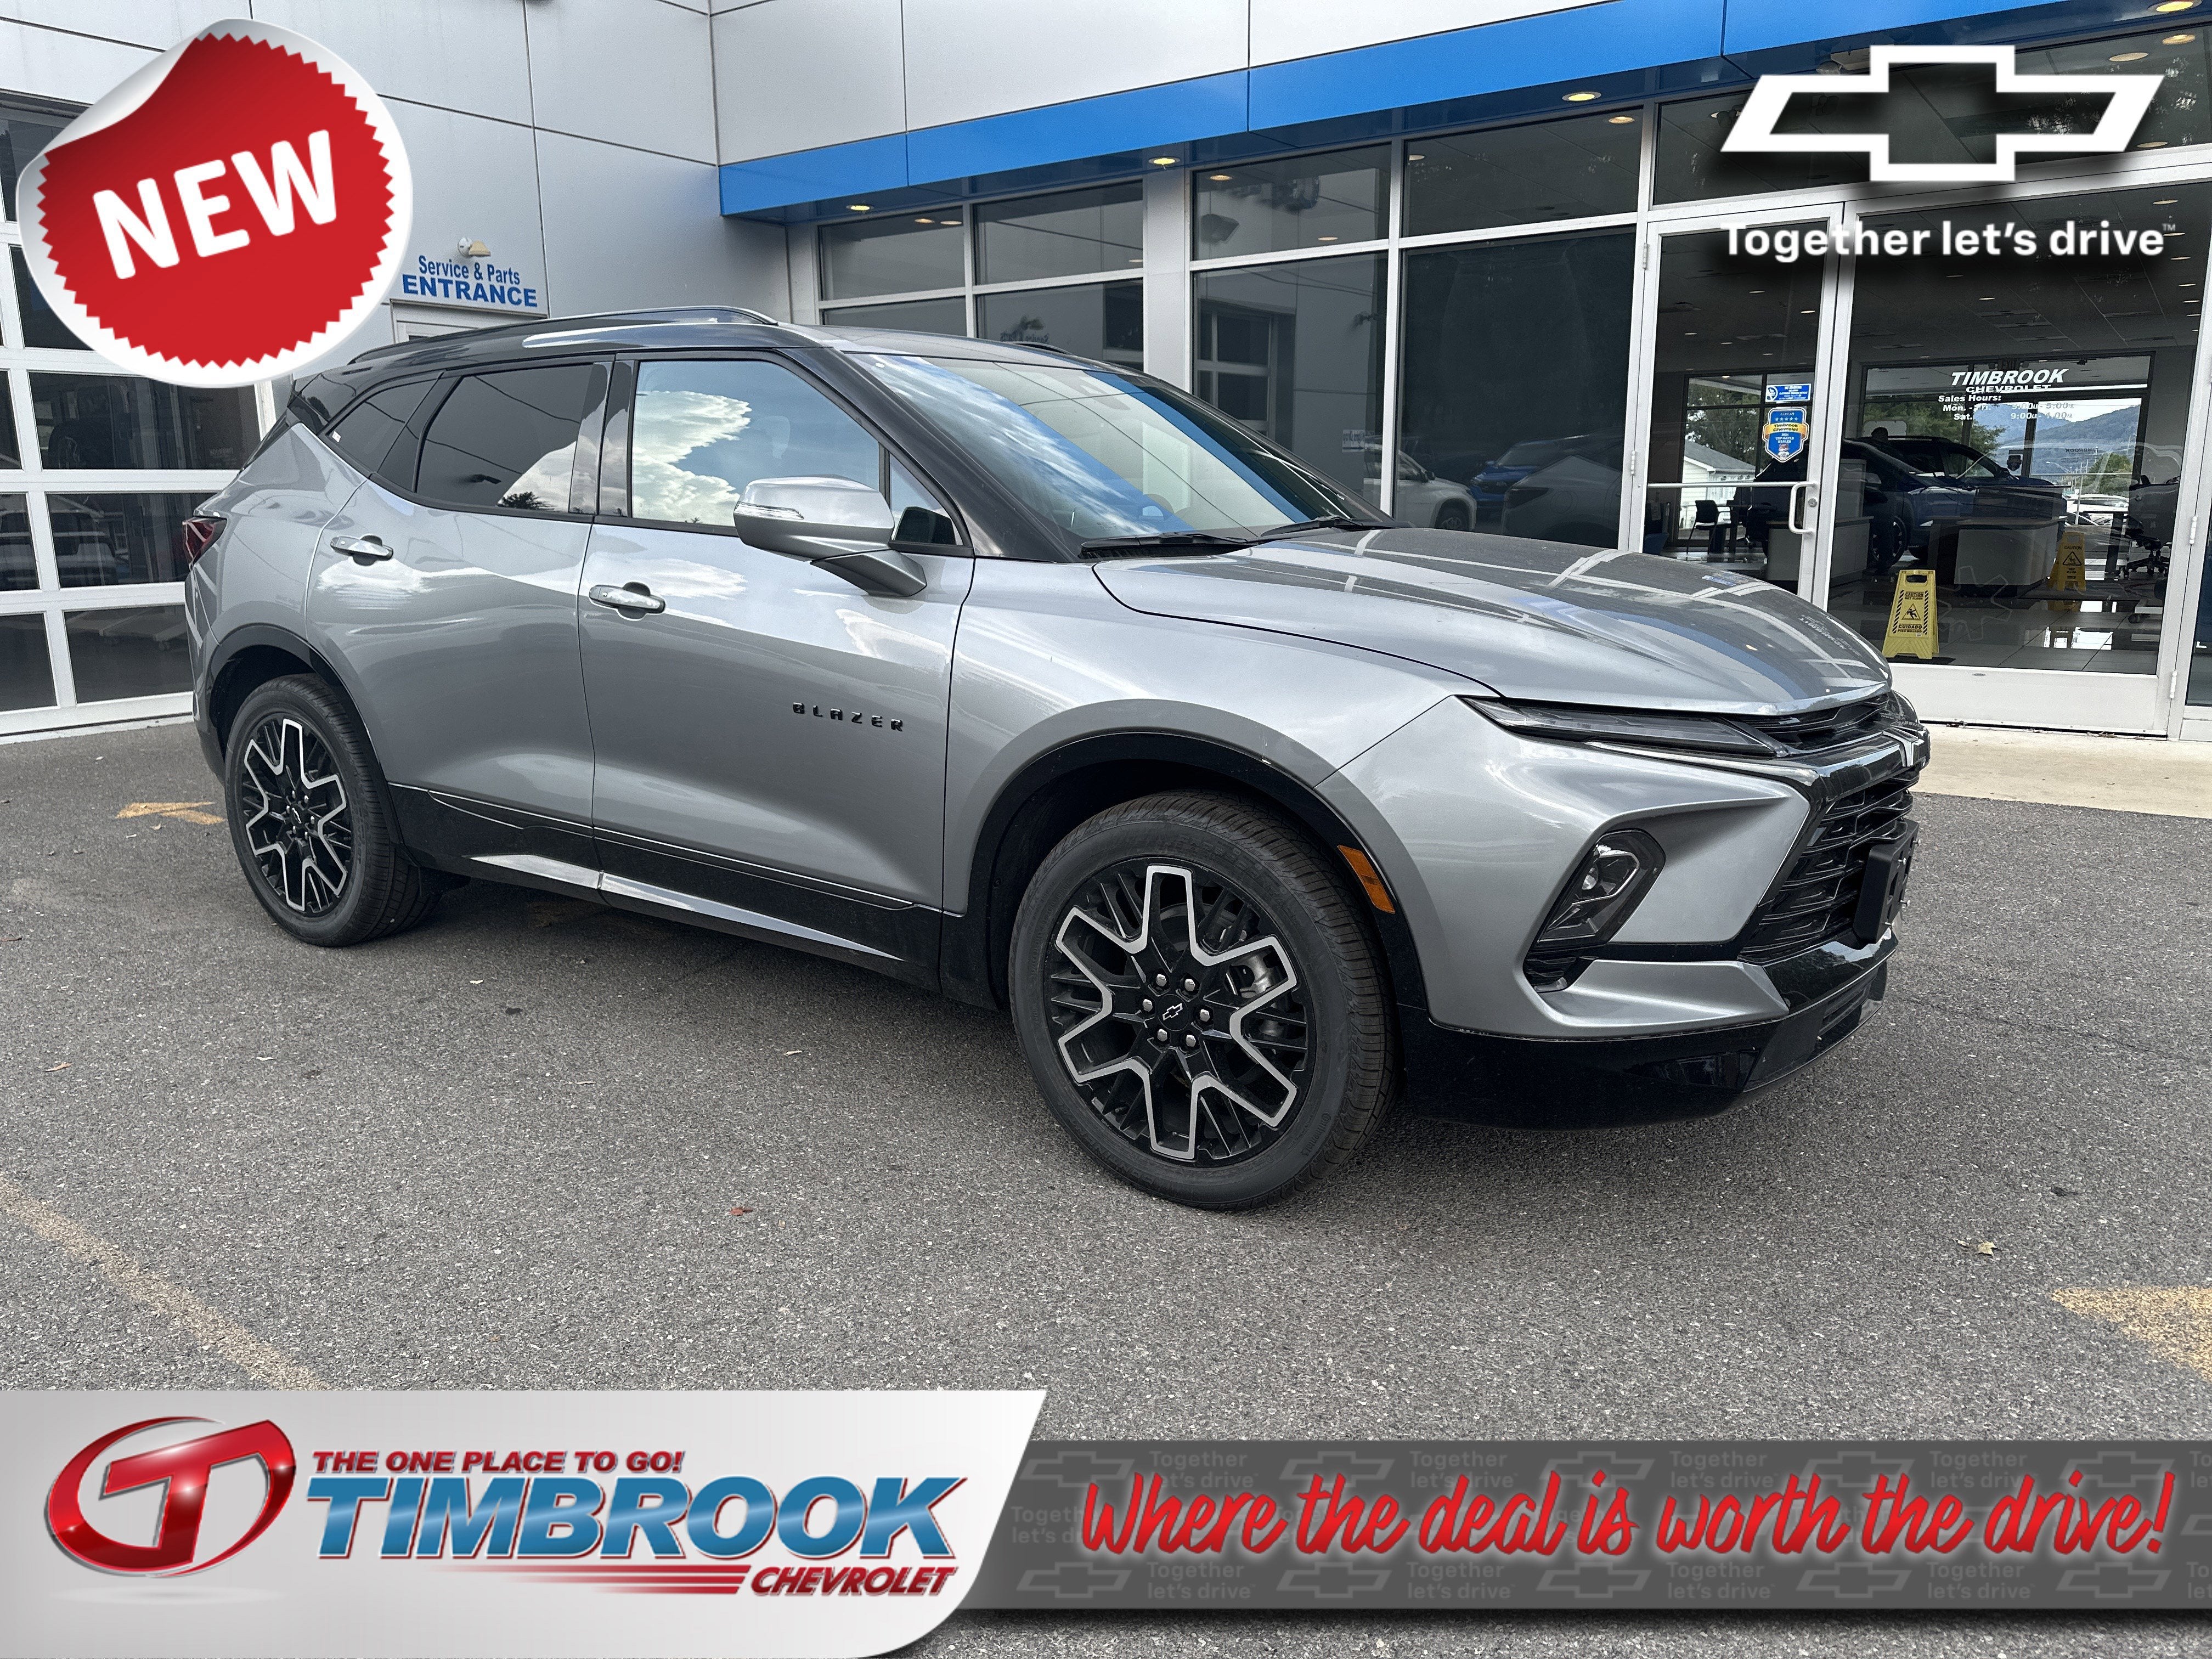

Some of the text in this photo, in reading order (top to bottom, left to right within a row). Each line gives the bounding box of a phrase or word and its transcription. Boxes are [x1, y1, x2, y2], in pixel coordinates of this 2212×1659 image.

[419, 255, 520, 285] Service & Parts
[402, 274, 538, 307] ENTRANCE
[1951, 369, 2069, 386] TIMBROOK
[1966, 384, 2052, 394] CHEVROLET
[793, 702, 903, 732] BLAZER
